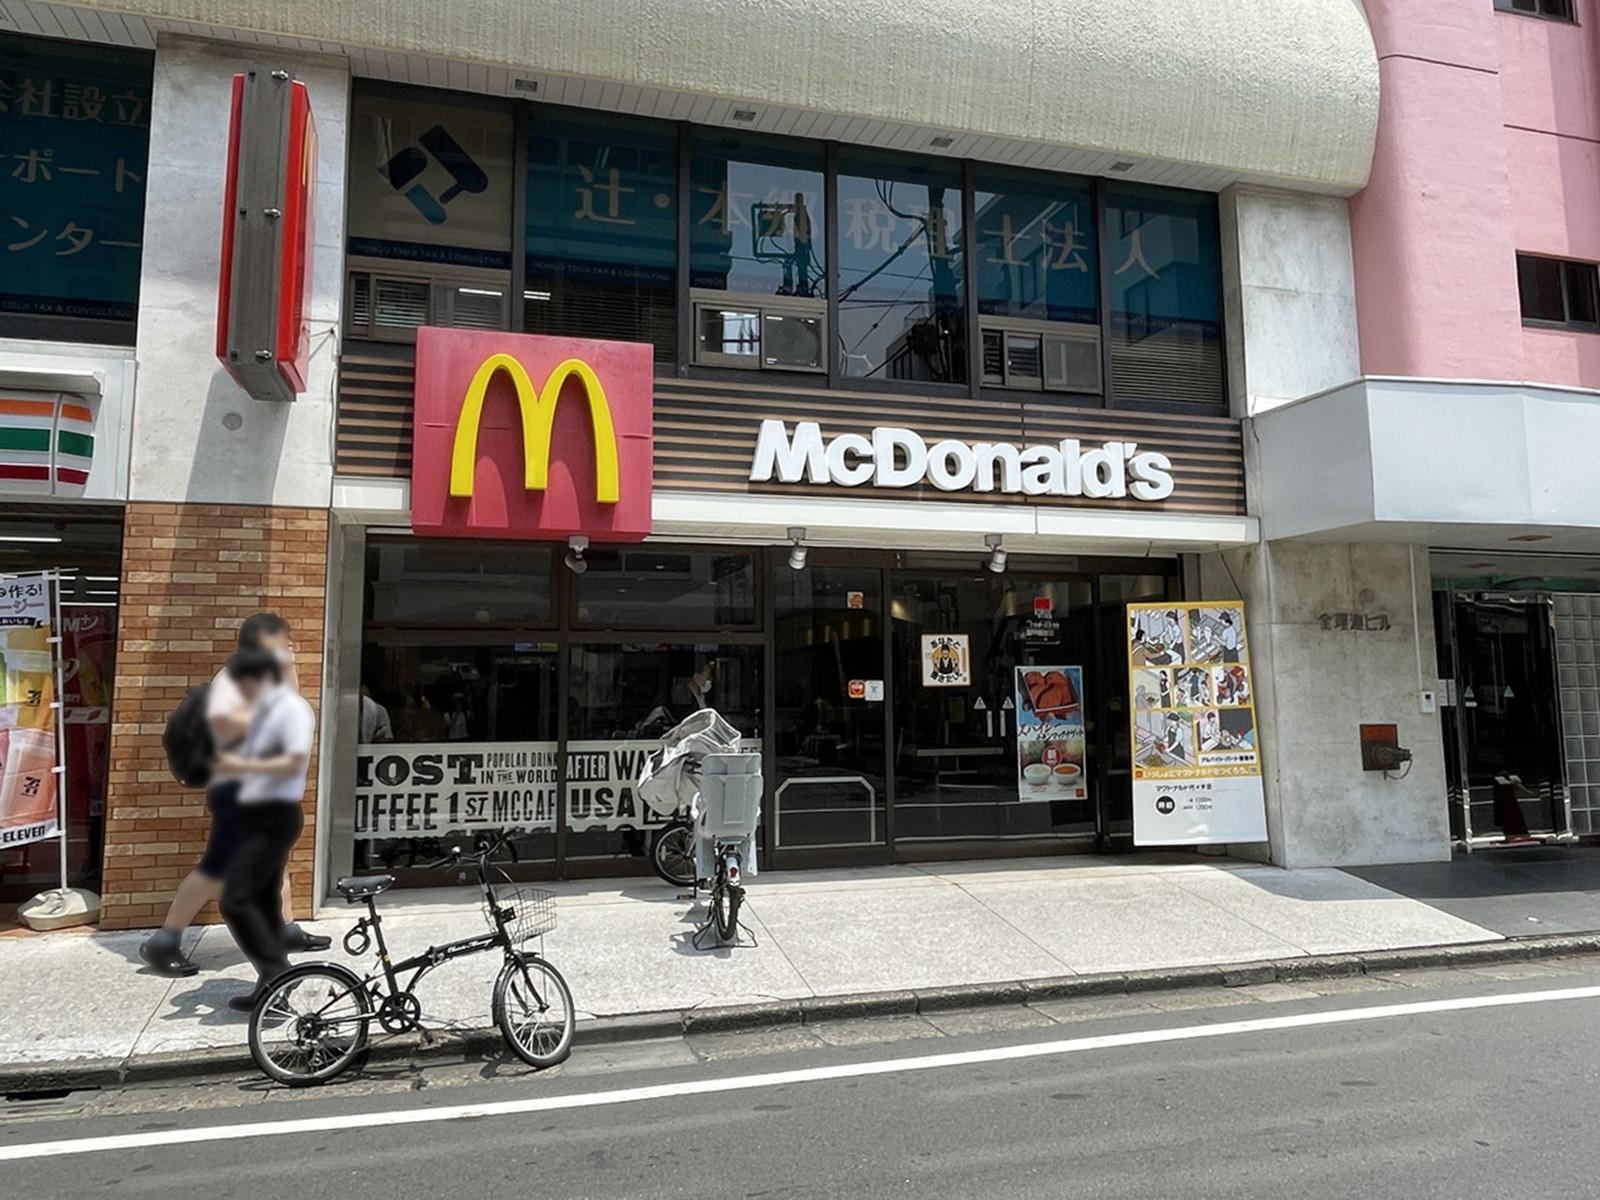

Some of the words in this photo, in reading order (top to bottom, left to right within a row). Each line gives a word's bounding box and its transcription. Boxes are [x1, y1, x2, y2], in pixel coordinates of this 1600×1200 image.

[0, 148, 143, 193] ポート
[748, 418, 1175, 501] McDonald's
[487, 752, 528, 768] POPULAR
[566, 755, 606, 780] AFTER
[481, 770, 494, 784] IN
[497, 772, 513, 783] THE
[516, 769, 558, 783] WORLD
[571, 787, 636, 818] USA
